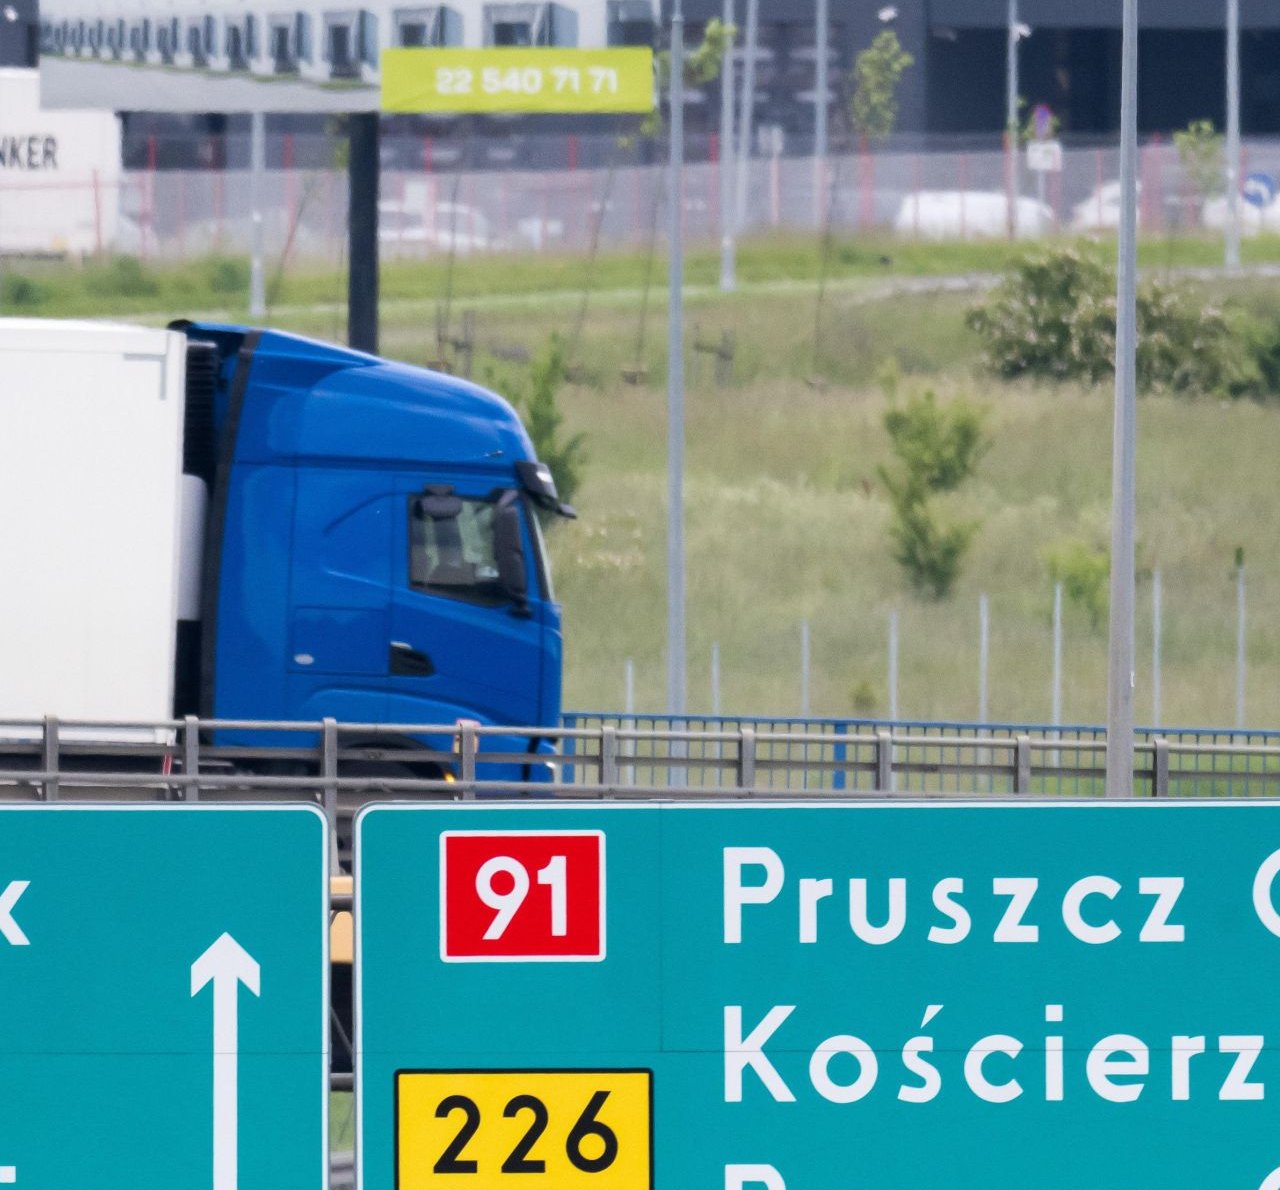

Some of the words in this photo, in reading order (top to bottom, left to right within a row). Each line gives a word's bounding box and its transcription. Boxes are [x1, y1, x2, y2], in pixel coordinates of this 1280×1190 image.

[436, 67, 471, 94] 22
[482, 67, 541, 94] 540
[551, 67, 580, 93] 71
[588, 67, 618, 93] 71
[475, 855, 568, 940] 91
[723, 846, 1185, 945] Pruszcz
[433, 1090, 619, 1174] 226
